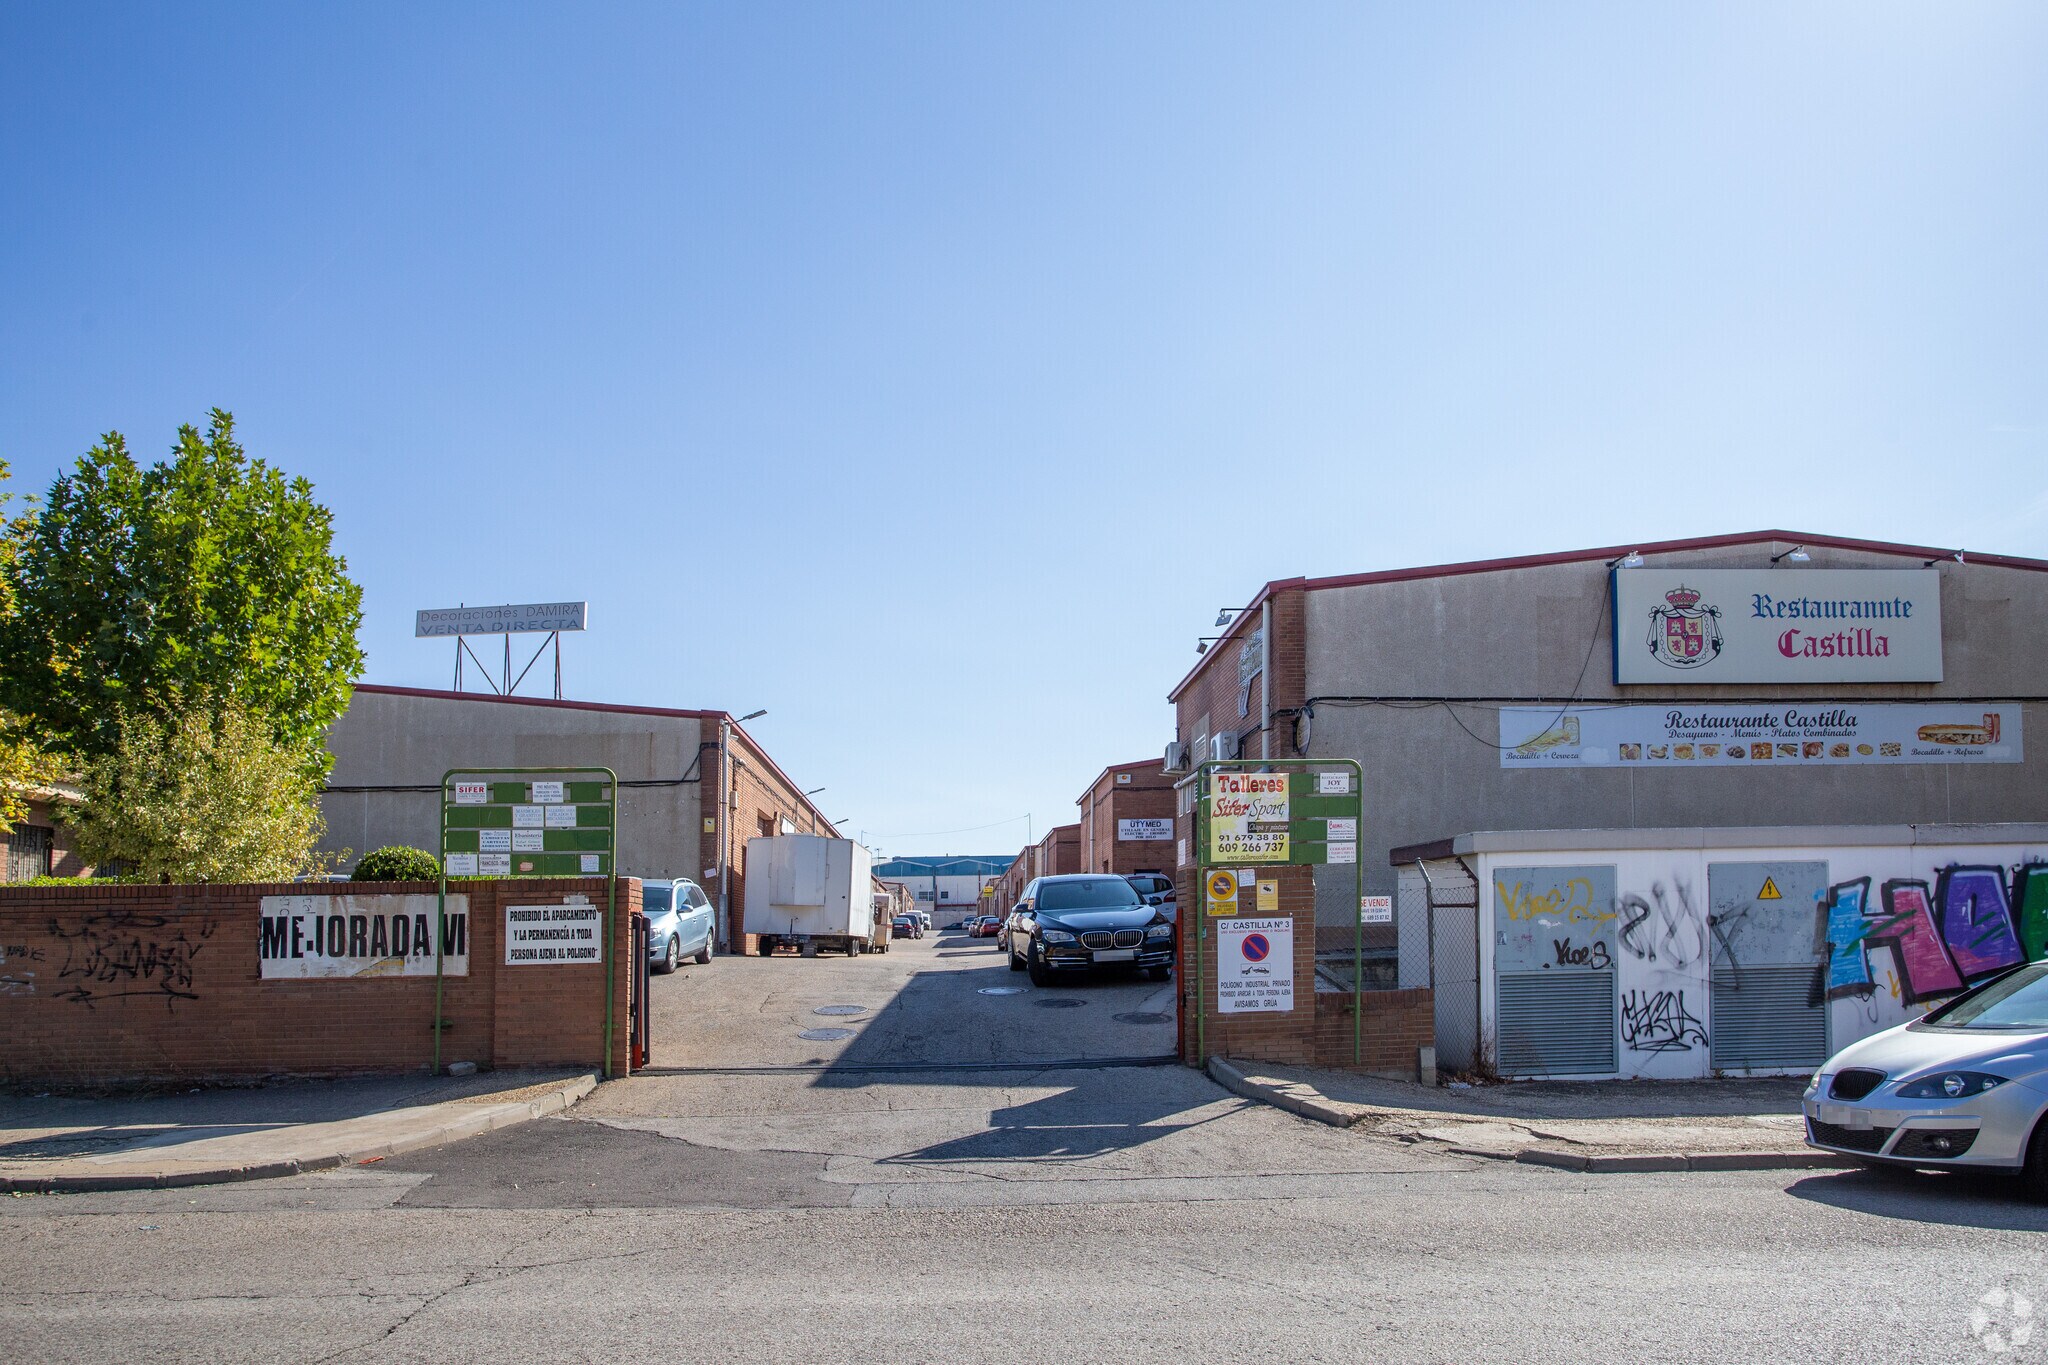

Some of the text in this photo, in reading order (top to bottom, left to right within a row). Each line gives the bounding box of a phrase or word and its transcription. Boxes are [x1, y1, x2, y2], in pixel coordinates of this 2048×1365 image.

[421, 604, 580, 622] Decoraciones DAMIRA
[421, 620, 578, 636] VENTA DIRECTA
[1778, 628, 1891, 658] Castilla
[1664, 709, 1858, 729] Restaurante Castilla
[1668, 729, 1718, 740] Desayunos
[1730, 728, 1762, 738] Menús
[1771, 728, 1801, 738] Platos
[1804, 728, 1856, 738] Combinados
[1954, 748, 1984, 756] Refresco
[1218, 775, 1284, 793] Talleres
[1212, 796, 1285, 821] Sifer Sport
[1218, 843, 1284, 852] 609 266 737
[510, 909, 596, 921] PROHIBIDO EL APARCAMIENTO
[514, 930, 518, 940] Y
[519, 930, 526, 940] LA
[571, 929, 575, 939] A
[577, 929, 592, 939] TODA
[511, 949, 537, 960] PERSONA
[539, 948, 556, 959] AJENA
[558, 948, 565, 959] AL
[1234, 1000, 1259, 1008] AVISAMOS
